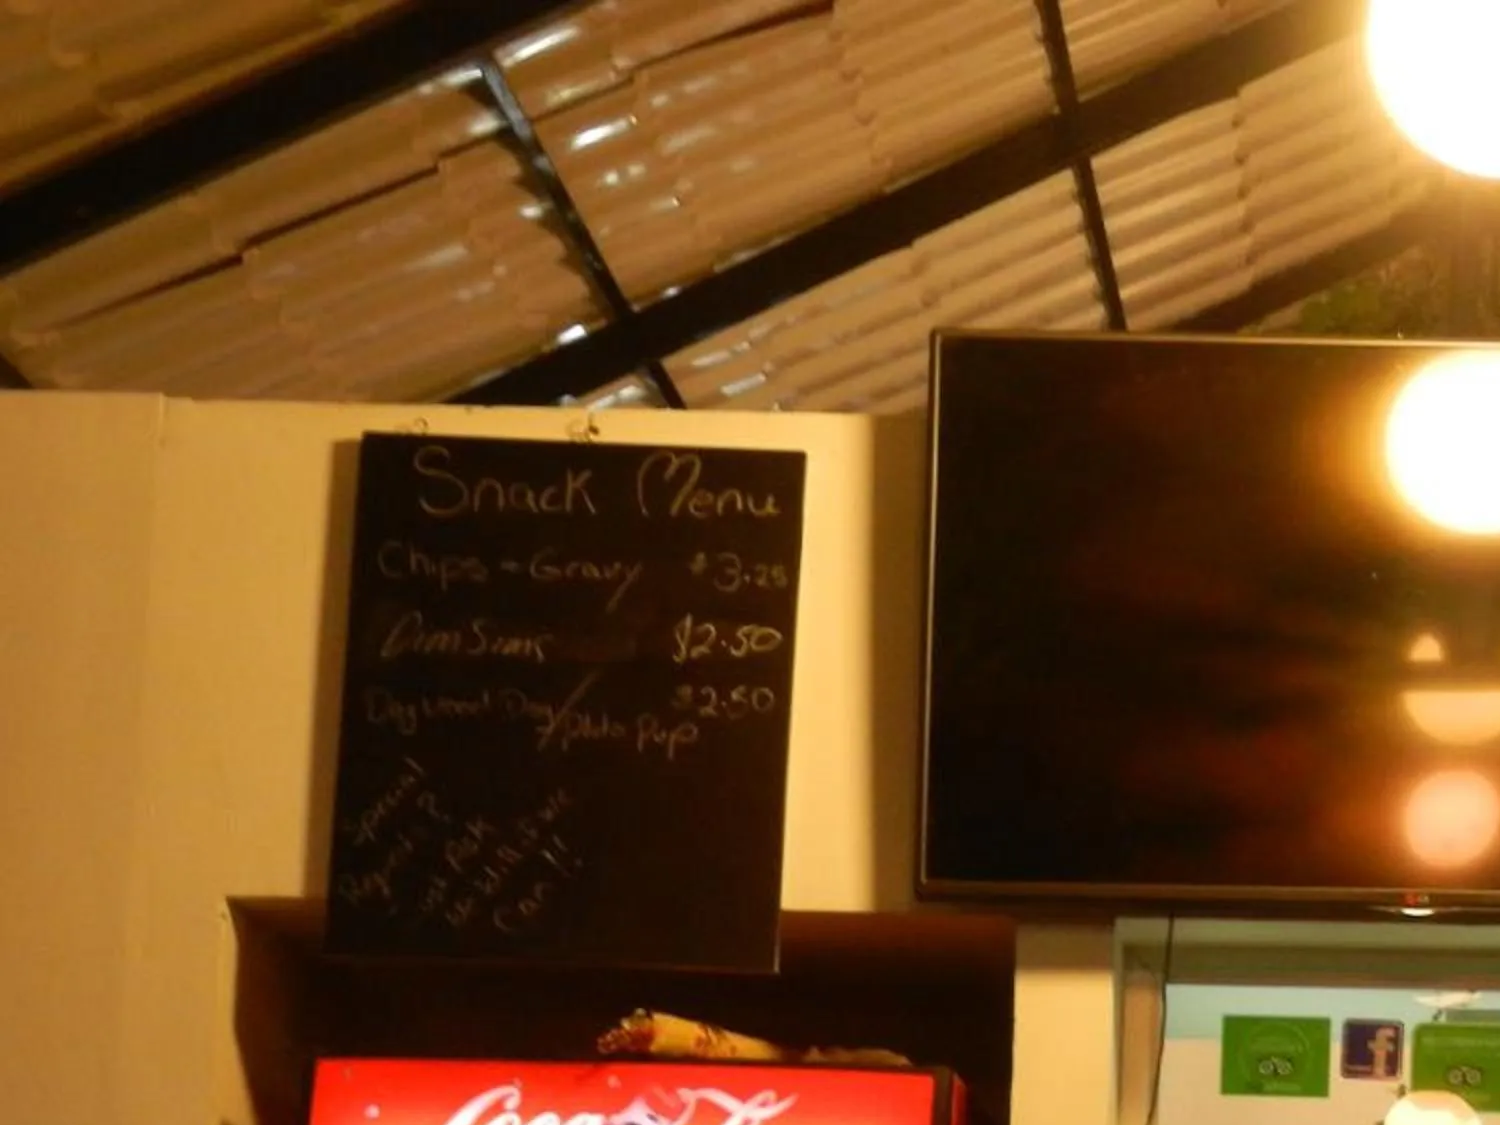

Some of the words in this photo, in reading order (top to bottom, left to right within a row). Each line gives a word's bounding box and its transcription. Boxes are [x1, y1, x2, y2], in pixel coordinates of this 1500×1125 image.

[413, 445, 597, 517] Snack
[637, 450, 783, 518] Menu
[377, 539, 490, 592] Chips
[528, 546, 645, 614] Gravy
[671, 611, 785, 664] $2.50
